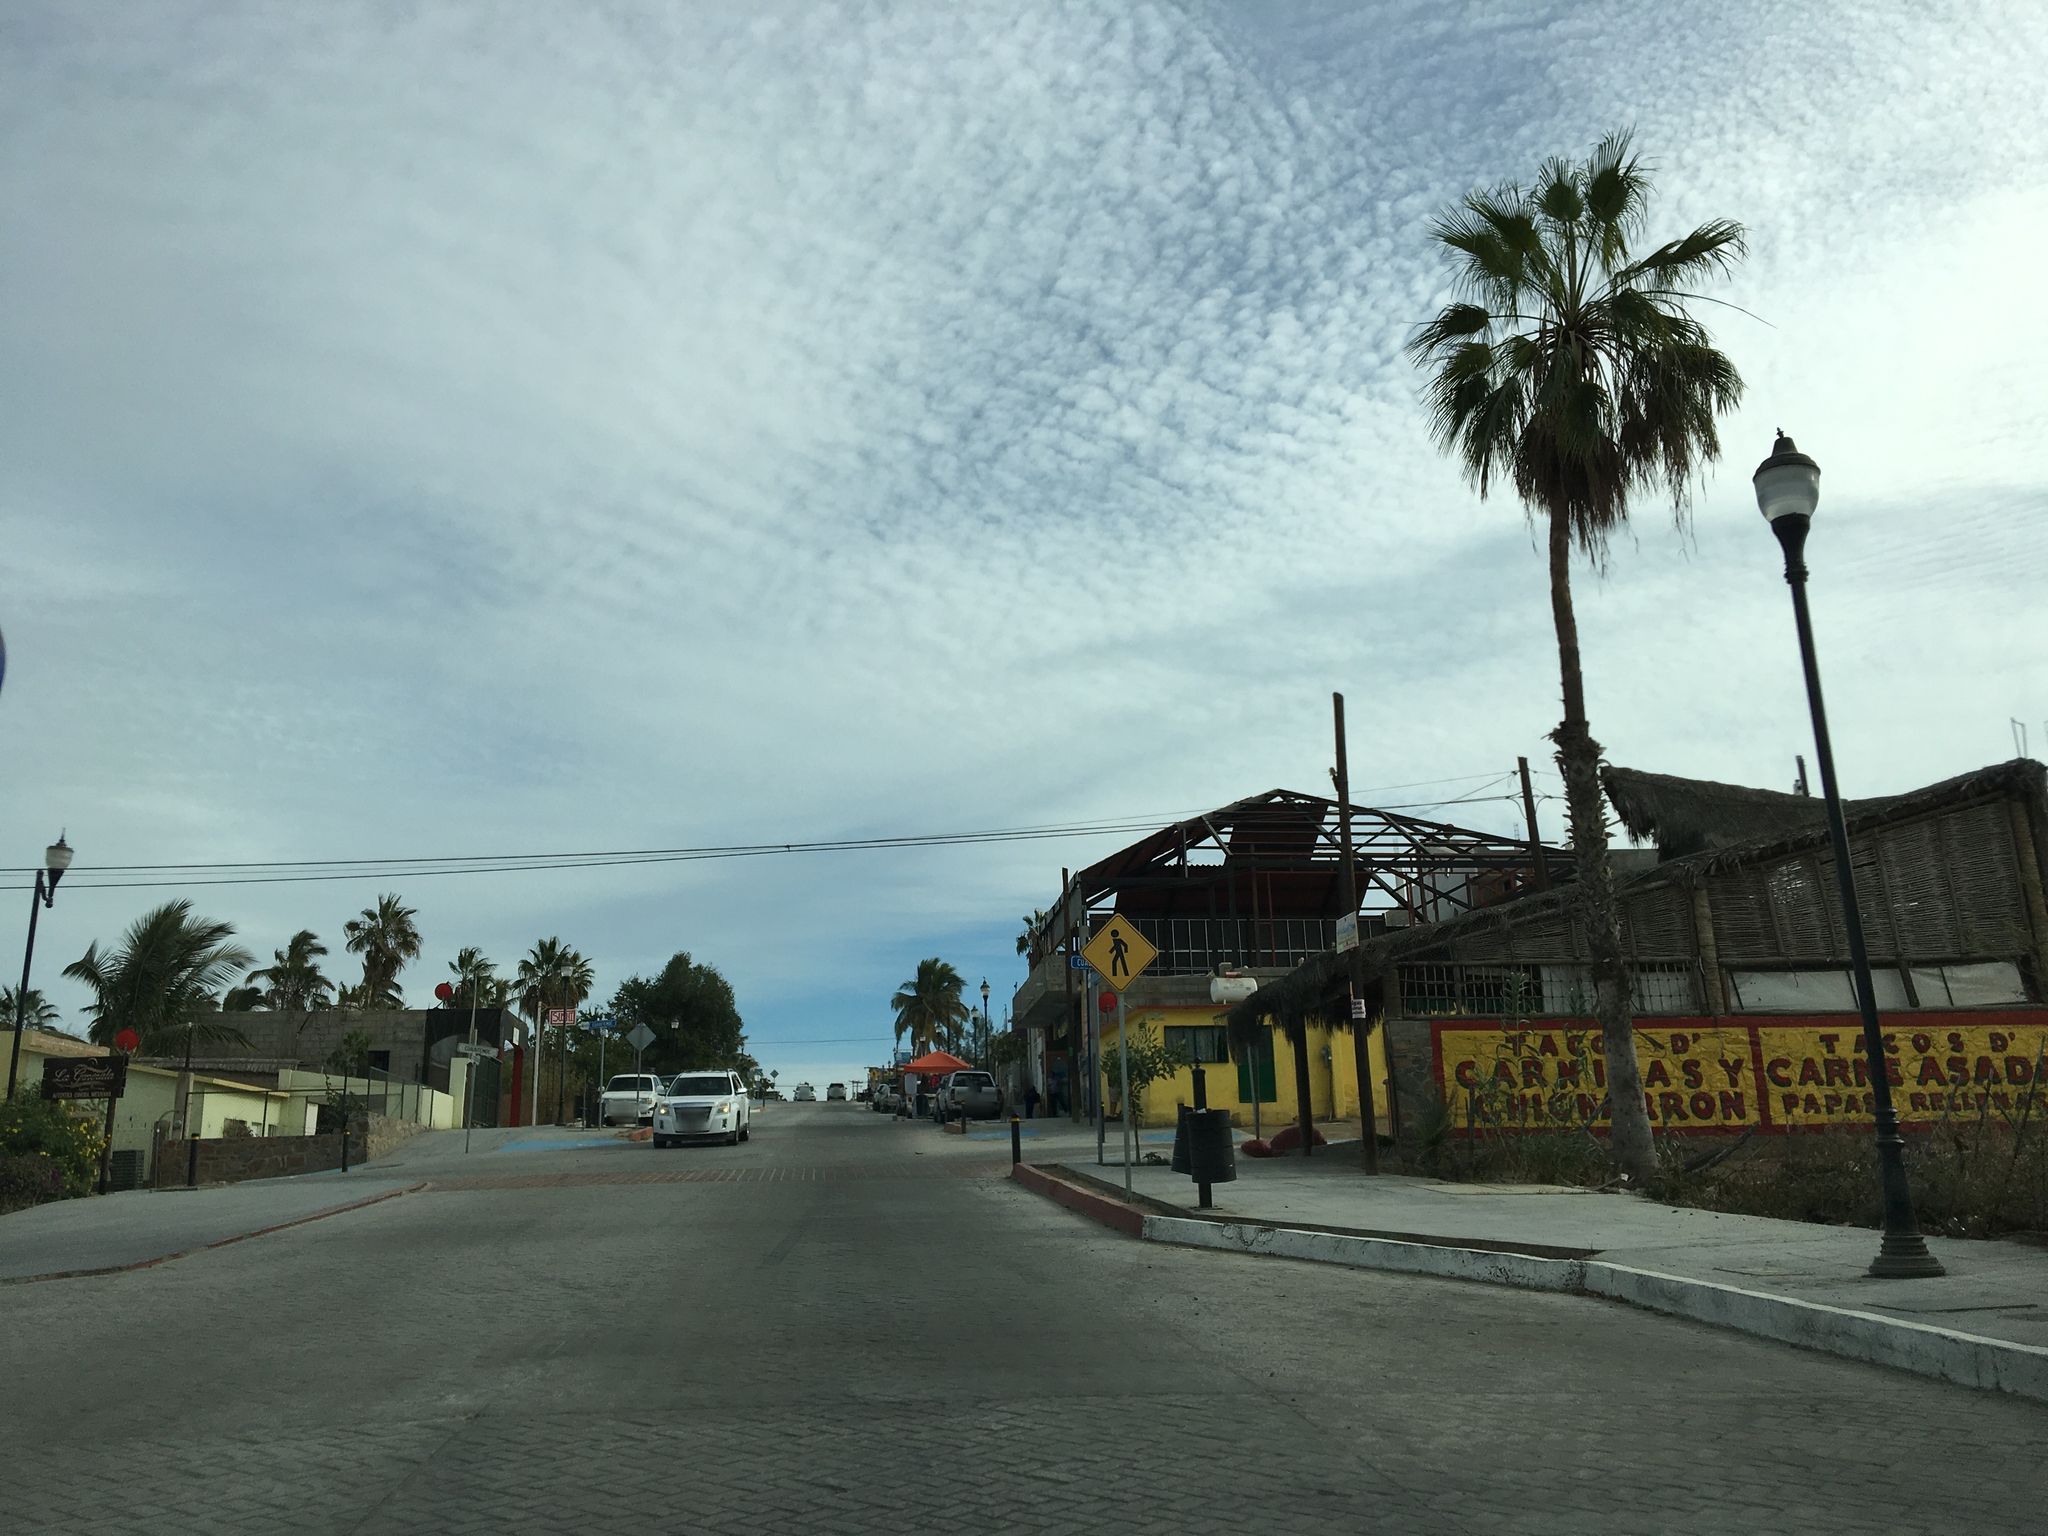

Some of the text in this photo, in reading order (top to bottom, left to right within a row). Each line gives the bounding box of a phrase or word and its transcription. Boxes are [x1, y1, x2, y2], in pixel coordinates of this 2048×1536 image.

[1505, 1034, 1607, 1057] TACO
[1819, 1032, 1965, 1055] TACOS
[1455, 1058, 1744, 1090] CARNIAS Y
[1766, 1056, 1905, 1088] CARNE
[1782, 1092, 1876, 1115] PAPAS
